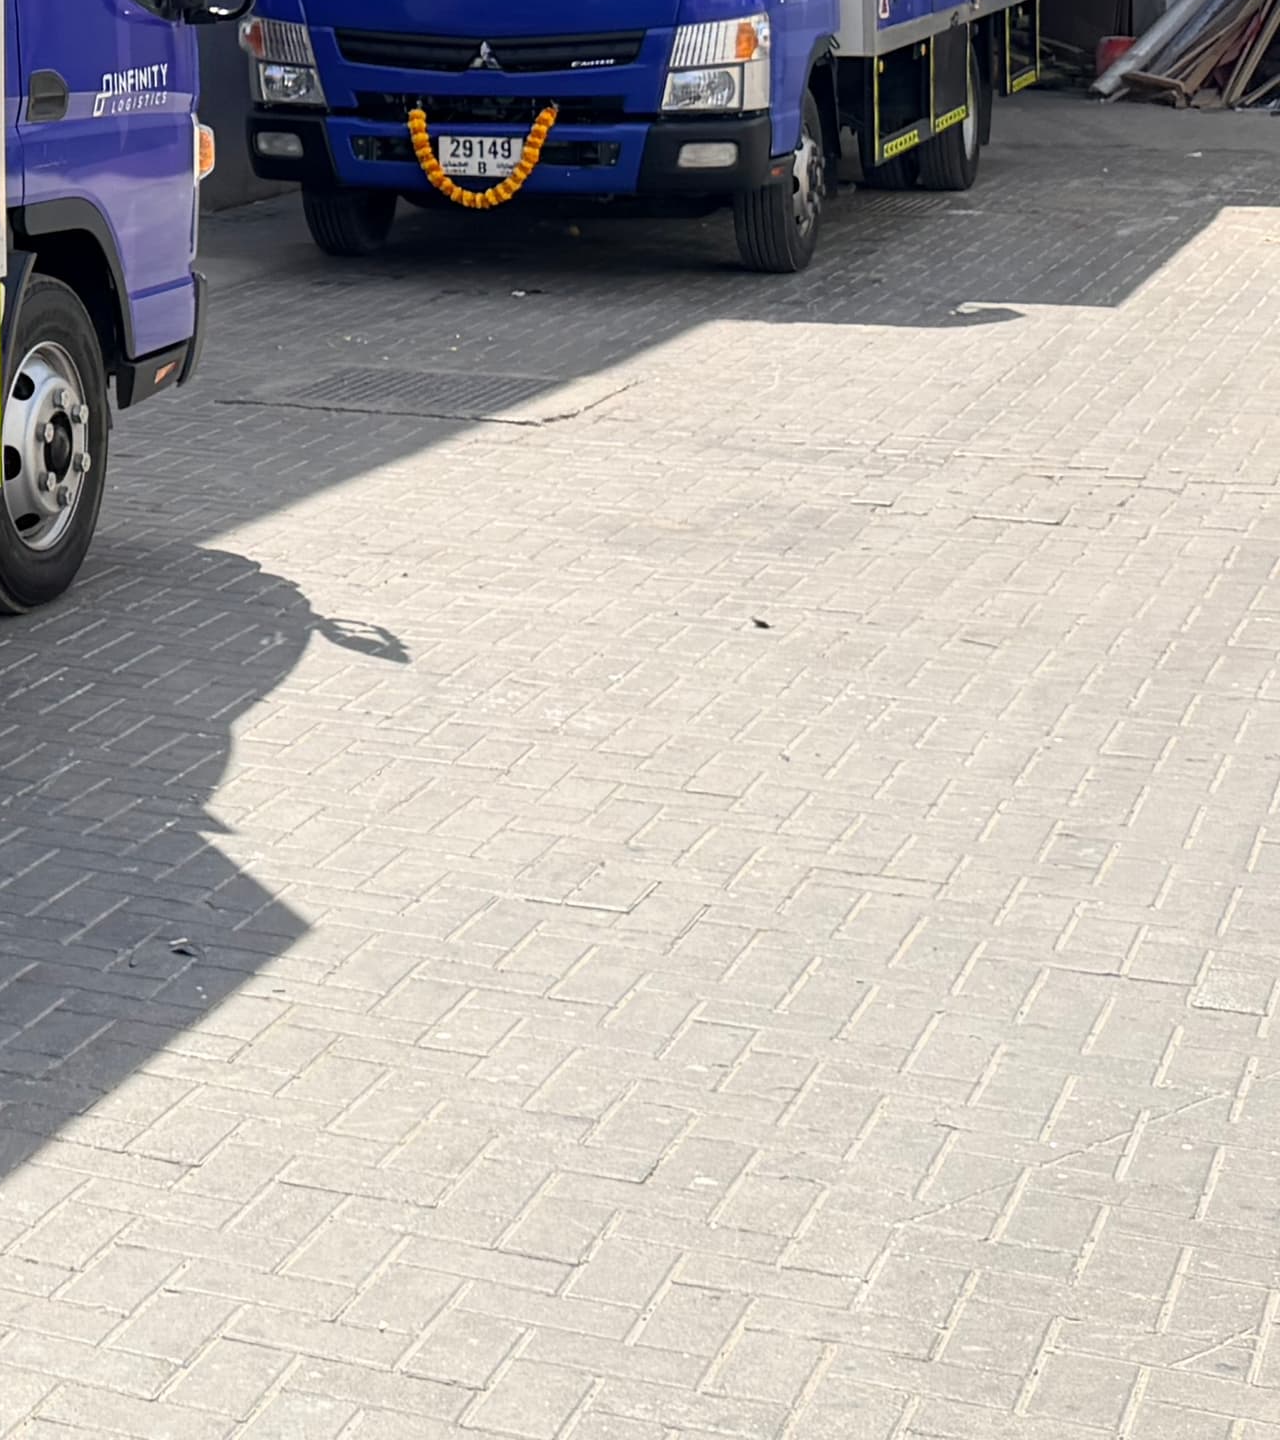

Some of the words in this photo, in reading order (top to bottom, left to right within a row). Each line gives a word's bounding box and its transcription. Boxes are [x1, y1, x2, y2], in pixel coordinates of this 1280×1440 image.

[113, 63, 168, 96] INFINITY
[111, 91, 168, 115] LOGISTICS
[450, 138, 511, 159] 29149
[478, 161, 487, 175] B
